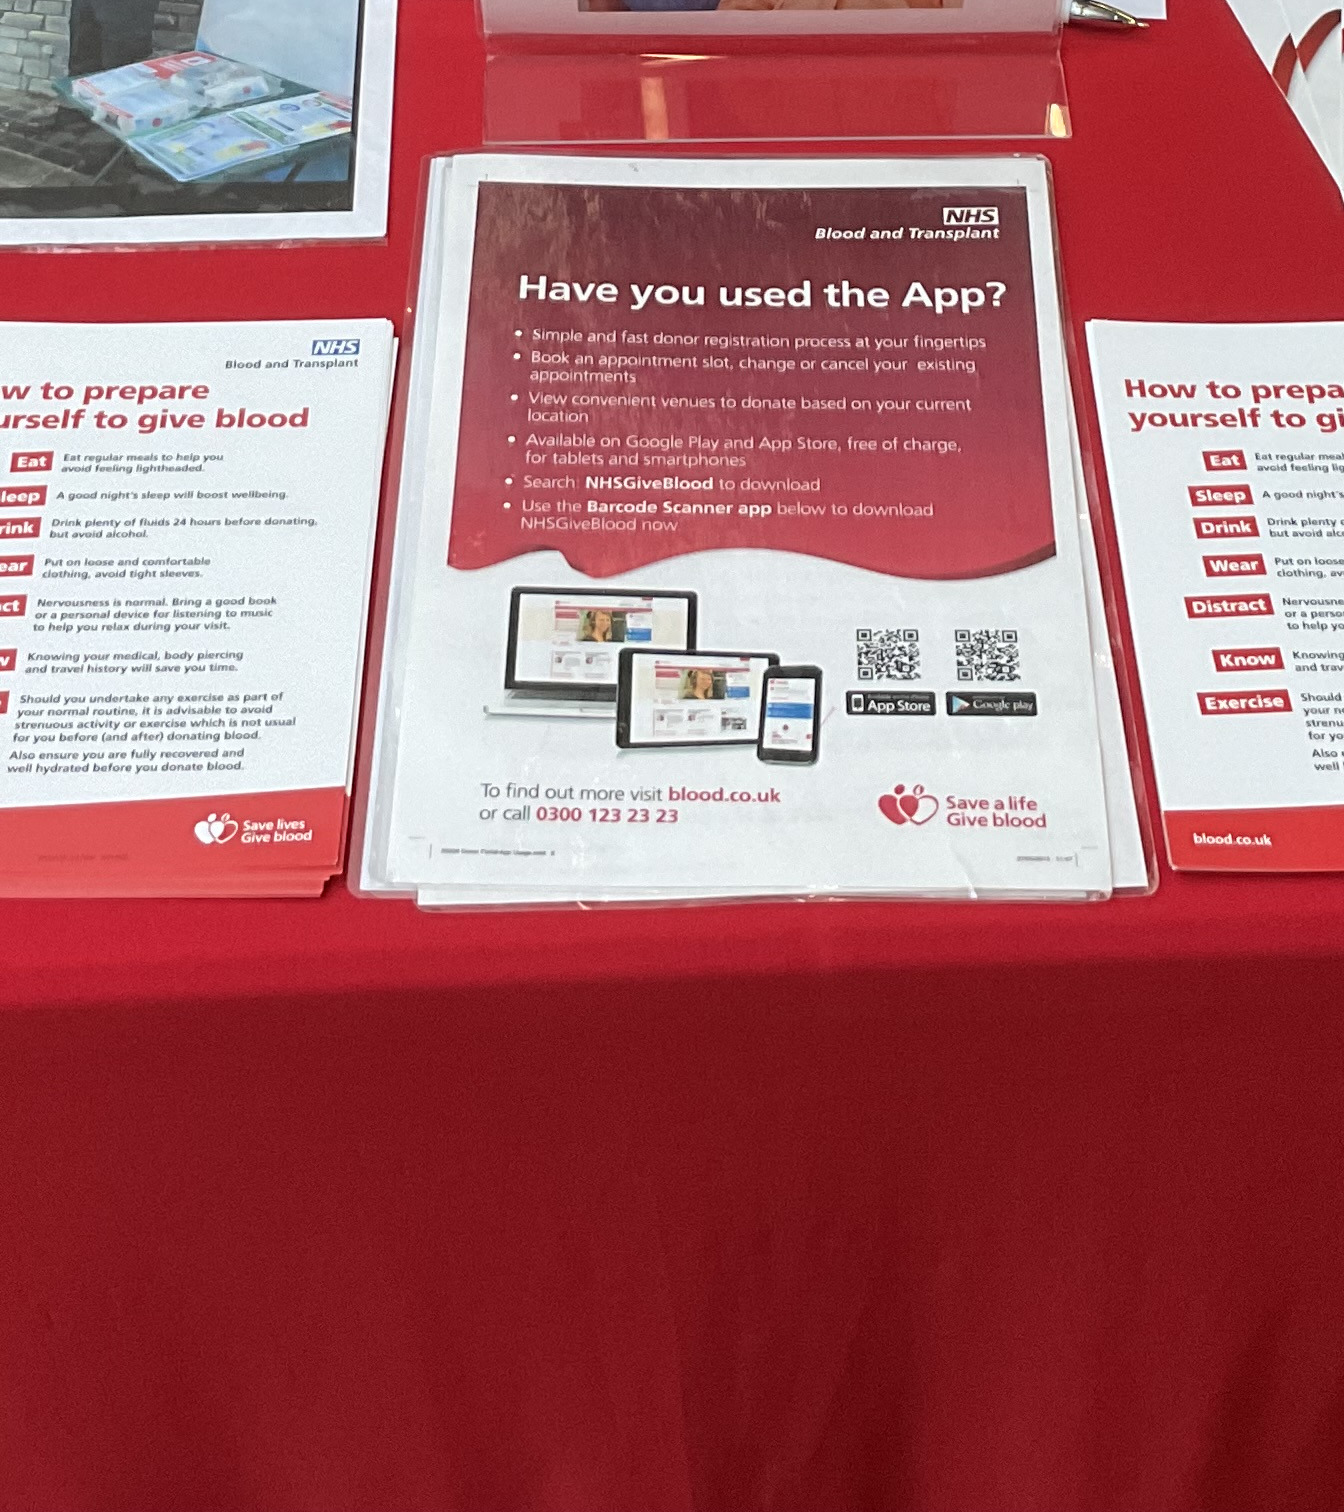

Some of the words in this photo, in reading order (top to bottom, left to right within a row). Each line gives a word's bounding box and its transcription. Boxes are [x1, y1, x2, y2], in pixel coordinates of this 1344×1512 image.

[946, 208, 994, 223] NHS
[814, 227, 865, 239] Blood
[869, 226, 903, 239] and
[908, 226, 999, 241] Transplant
[519, 274, 618, 302] Have
[630, 284, 704, 310] you
[719, 280, 811, 307] used
[823, 280, 889, 307] the
[901, 281, 1006, 314] App?
[532, 328, 582, 343] Simple
[587, 330, 617, 342] and
[621, 329, 648, 343] fast
[653, 331, 699, 344] donor
[704, 335, 789, 348] registration
[794, 337, 851, 349] process
[855, 336, 870, 348] at
[874, 338, 908, 350] your
[913, 334, 986, 350] fingertips
[40, 381, 74, 400] to
[82, 385, 209, 405] prepare
[1124, 378, 1196, 398] How
[1205, 380, 1241, 398] to
[93, 410, 127, 428] to
[137, 408, 205, 433] give
[215, 407, 309, 427] blood
[1127, 407, 1260, 432] yourself
[1269, 409, 1306, 427] to
[17, 455, 46, 467] Eat
[585, 475, 713, 489] NHSGiveBlood
[719, 478, 735, 489] to
[740, 477, 820, 490] download
[480, 782, 500, 798] To
[506, 782, 539, 798] find
[544, 787, 574, 799] out
[580, 788, 624, 801] more
[630, 788, 662, 801] visit
[668, 785, 780, 802] blood.co.uk
[946, 795, 989, 809] Save
[993, 799, 1004, 810] a
[1008, 795, 1037, 810] life
[479, 808, 497, 820] or
[502, 805, 530, 820] call
[536, 806, 582, 821] 0300
[588, 807, 621, 822] 123
[627, 808, 649, 822] 23
[655, 808, 678, 823] 23
[946, 812, 987, 826] Give
[992, 812, 1046, 827] blood
[1193, 832, 1271, 845] blood.co.uk
